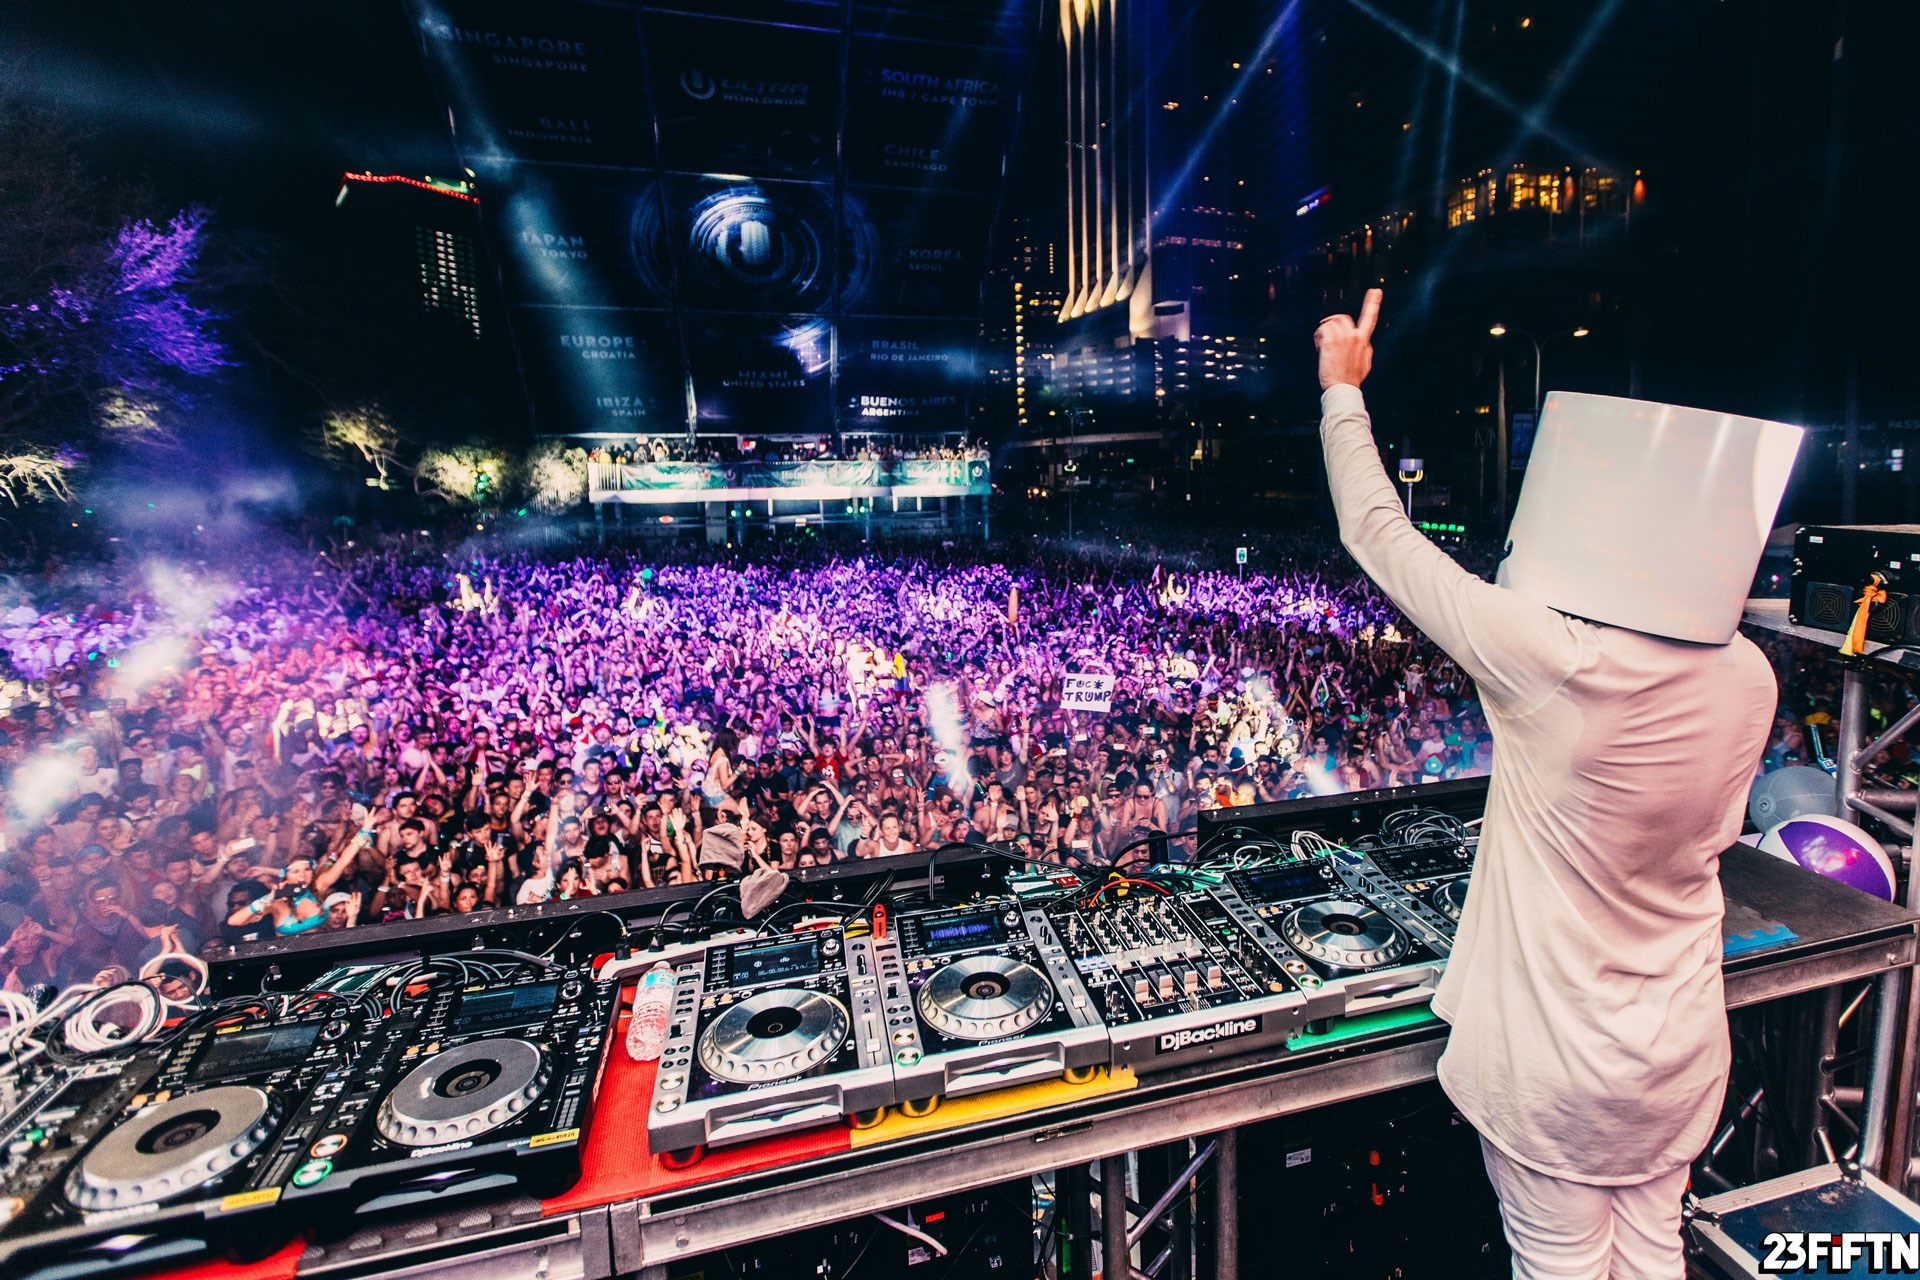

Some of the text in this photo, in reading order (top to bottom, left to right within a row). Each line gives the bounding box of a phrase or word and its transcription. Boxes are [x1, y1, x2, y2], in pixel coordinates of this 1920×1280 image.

[492, 53, 589, 72] SINGAPORE
[721, 78, 808, 94] ULTRA
[881, 69, 999, 94] SOUTH AFRICA
[722, 93, 807, 105] WORLDWIDE
[920, 93, 958, 105] CAPE
[960, 96, 999, 107] TOWN
[539, 117, 589, 131] BALI
[884, 144, 941, 161] CHILE
[884, 159, 948, 173] SANTIAGO
[909, 248, 963, 260] KOREA
[909, 263, 945, 272] SEOUL
[560, 335, 636, 348] EUROPE
[872, 340, 919, 351] BRASIL
[581, 350, 637, 360] CROATIA
[870, 353, 949, 362] RIO DE JANEIRO
[738, 370, 788, 380] MIAMI
[723, 380, 805, 389] UNITED STATES
[597, 396, 645, 407] IBIZA
[861, 396, 957, 407] BUENOS AIRES
[612, 409, 646, 417] SPAIN
[861, 407, 920, 417] ARGENTINA
[1065, 690, 1112, 702] TRUMP
[1160, 1018, 1257, 1050] DjBackline
[978, 1034, 1025, 1047] Pioneer
[748, 1075, 802, 1091] Pioneer
